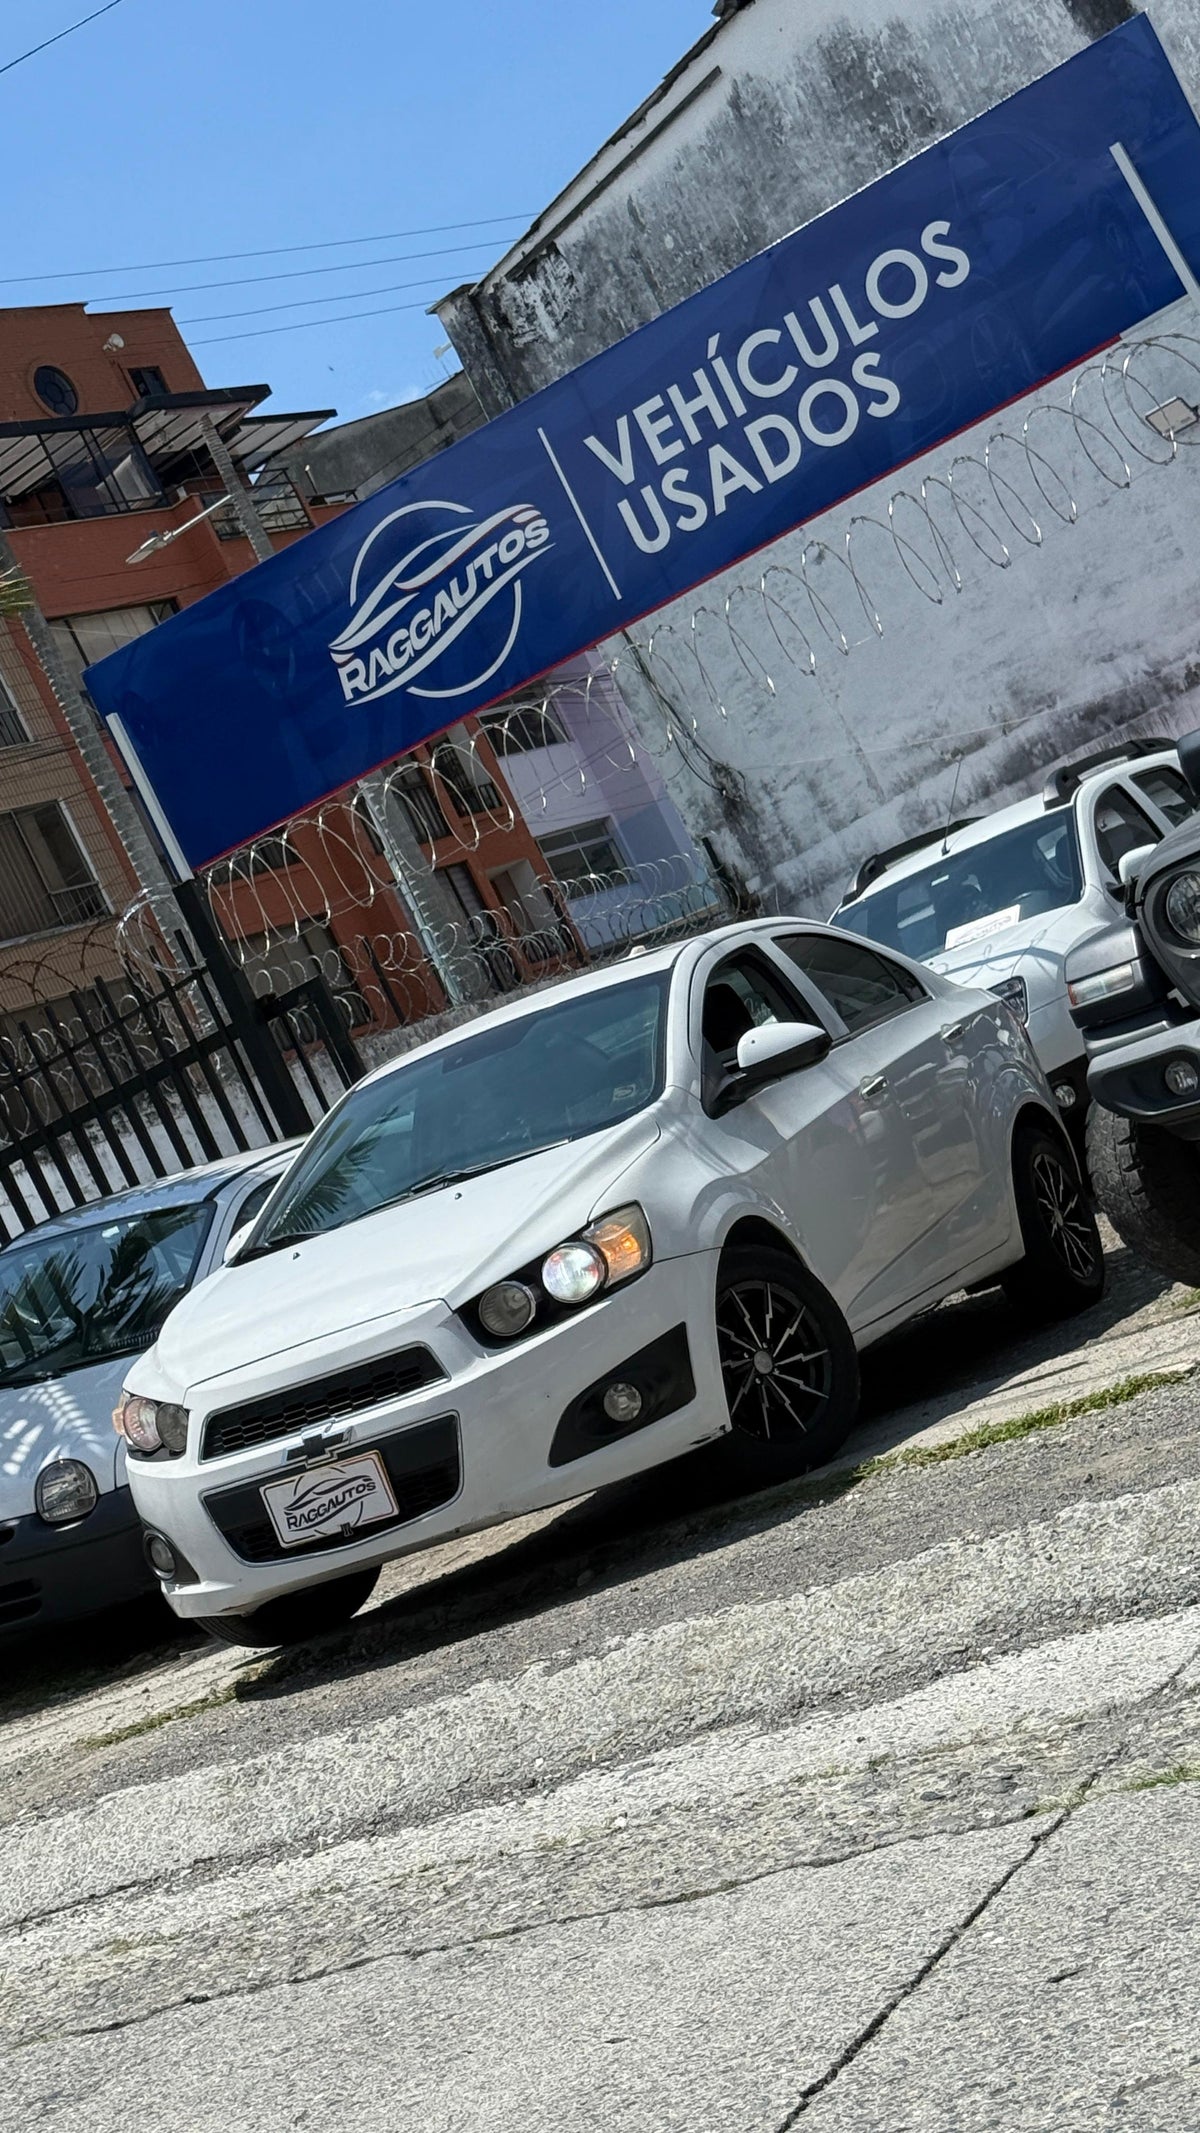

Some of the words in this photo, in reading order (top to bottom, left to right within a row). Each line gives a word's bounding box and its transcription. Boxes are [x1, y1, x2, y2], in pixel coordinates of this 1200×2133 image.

[583, 220, 970, 486] VEHÍCULOS
[617, 352, 900, 555] USADOS
[337, 518, 550, 701] RAGGAUTOS
[286, 1481, 376, 1529] RAGGAUTOS
